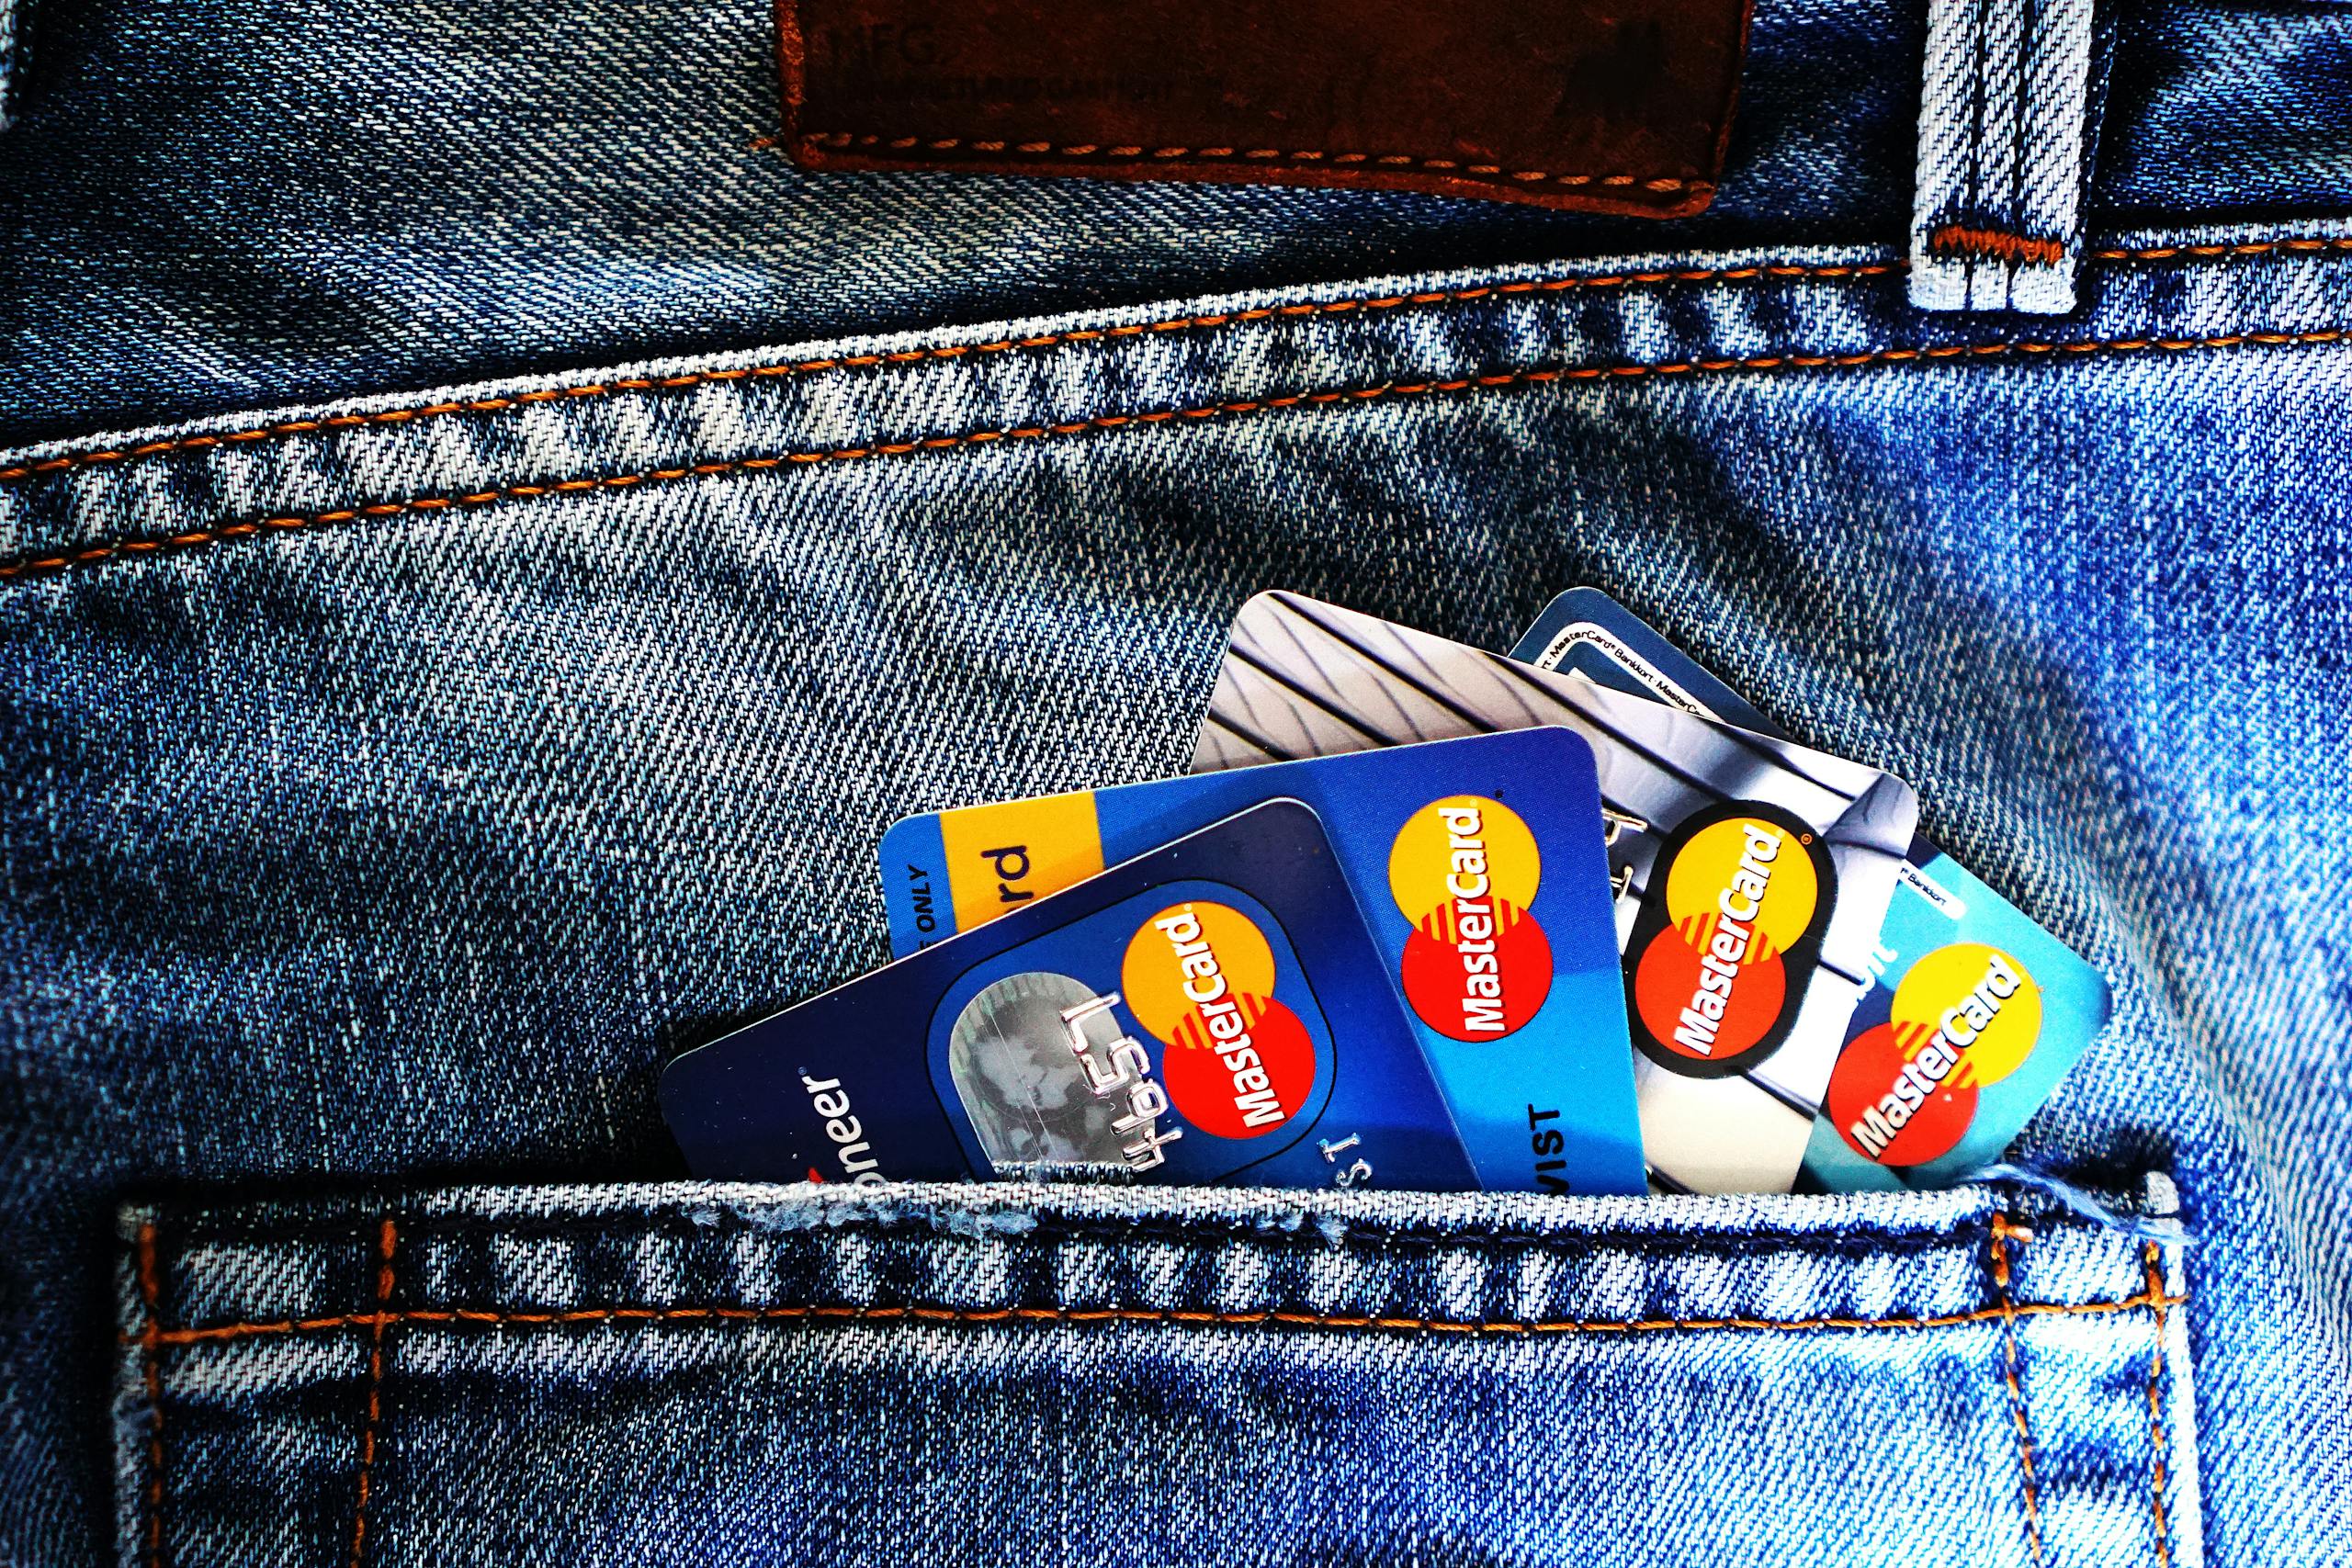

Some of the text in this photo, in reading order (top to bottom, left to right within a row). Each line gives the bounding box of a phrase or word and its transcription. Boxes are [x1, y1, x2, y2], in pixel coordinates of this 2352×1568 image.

[1656, 680, 1705, 717] MasterCa
[908, 863, 936, 933] ONLY
[980, 845, 1035, 914] rd
[1436, 807, 1508, 1032] MasterCard
[1673, 823, 1783, 1056] MasterCard
[1058, 990, 1185, 1174] 4657
[1155, 909, 1285, 1129] MasterCard
[1850, 953, 2020, 1160] MasterCard
